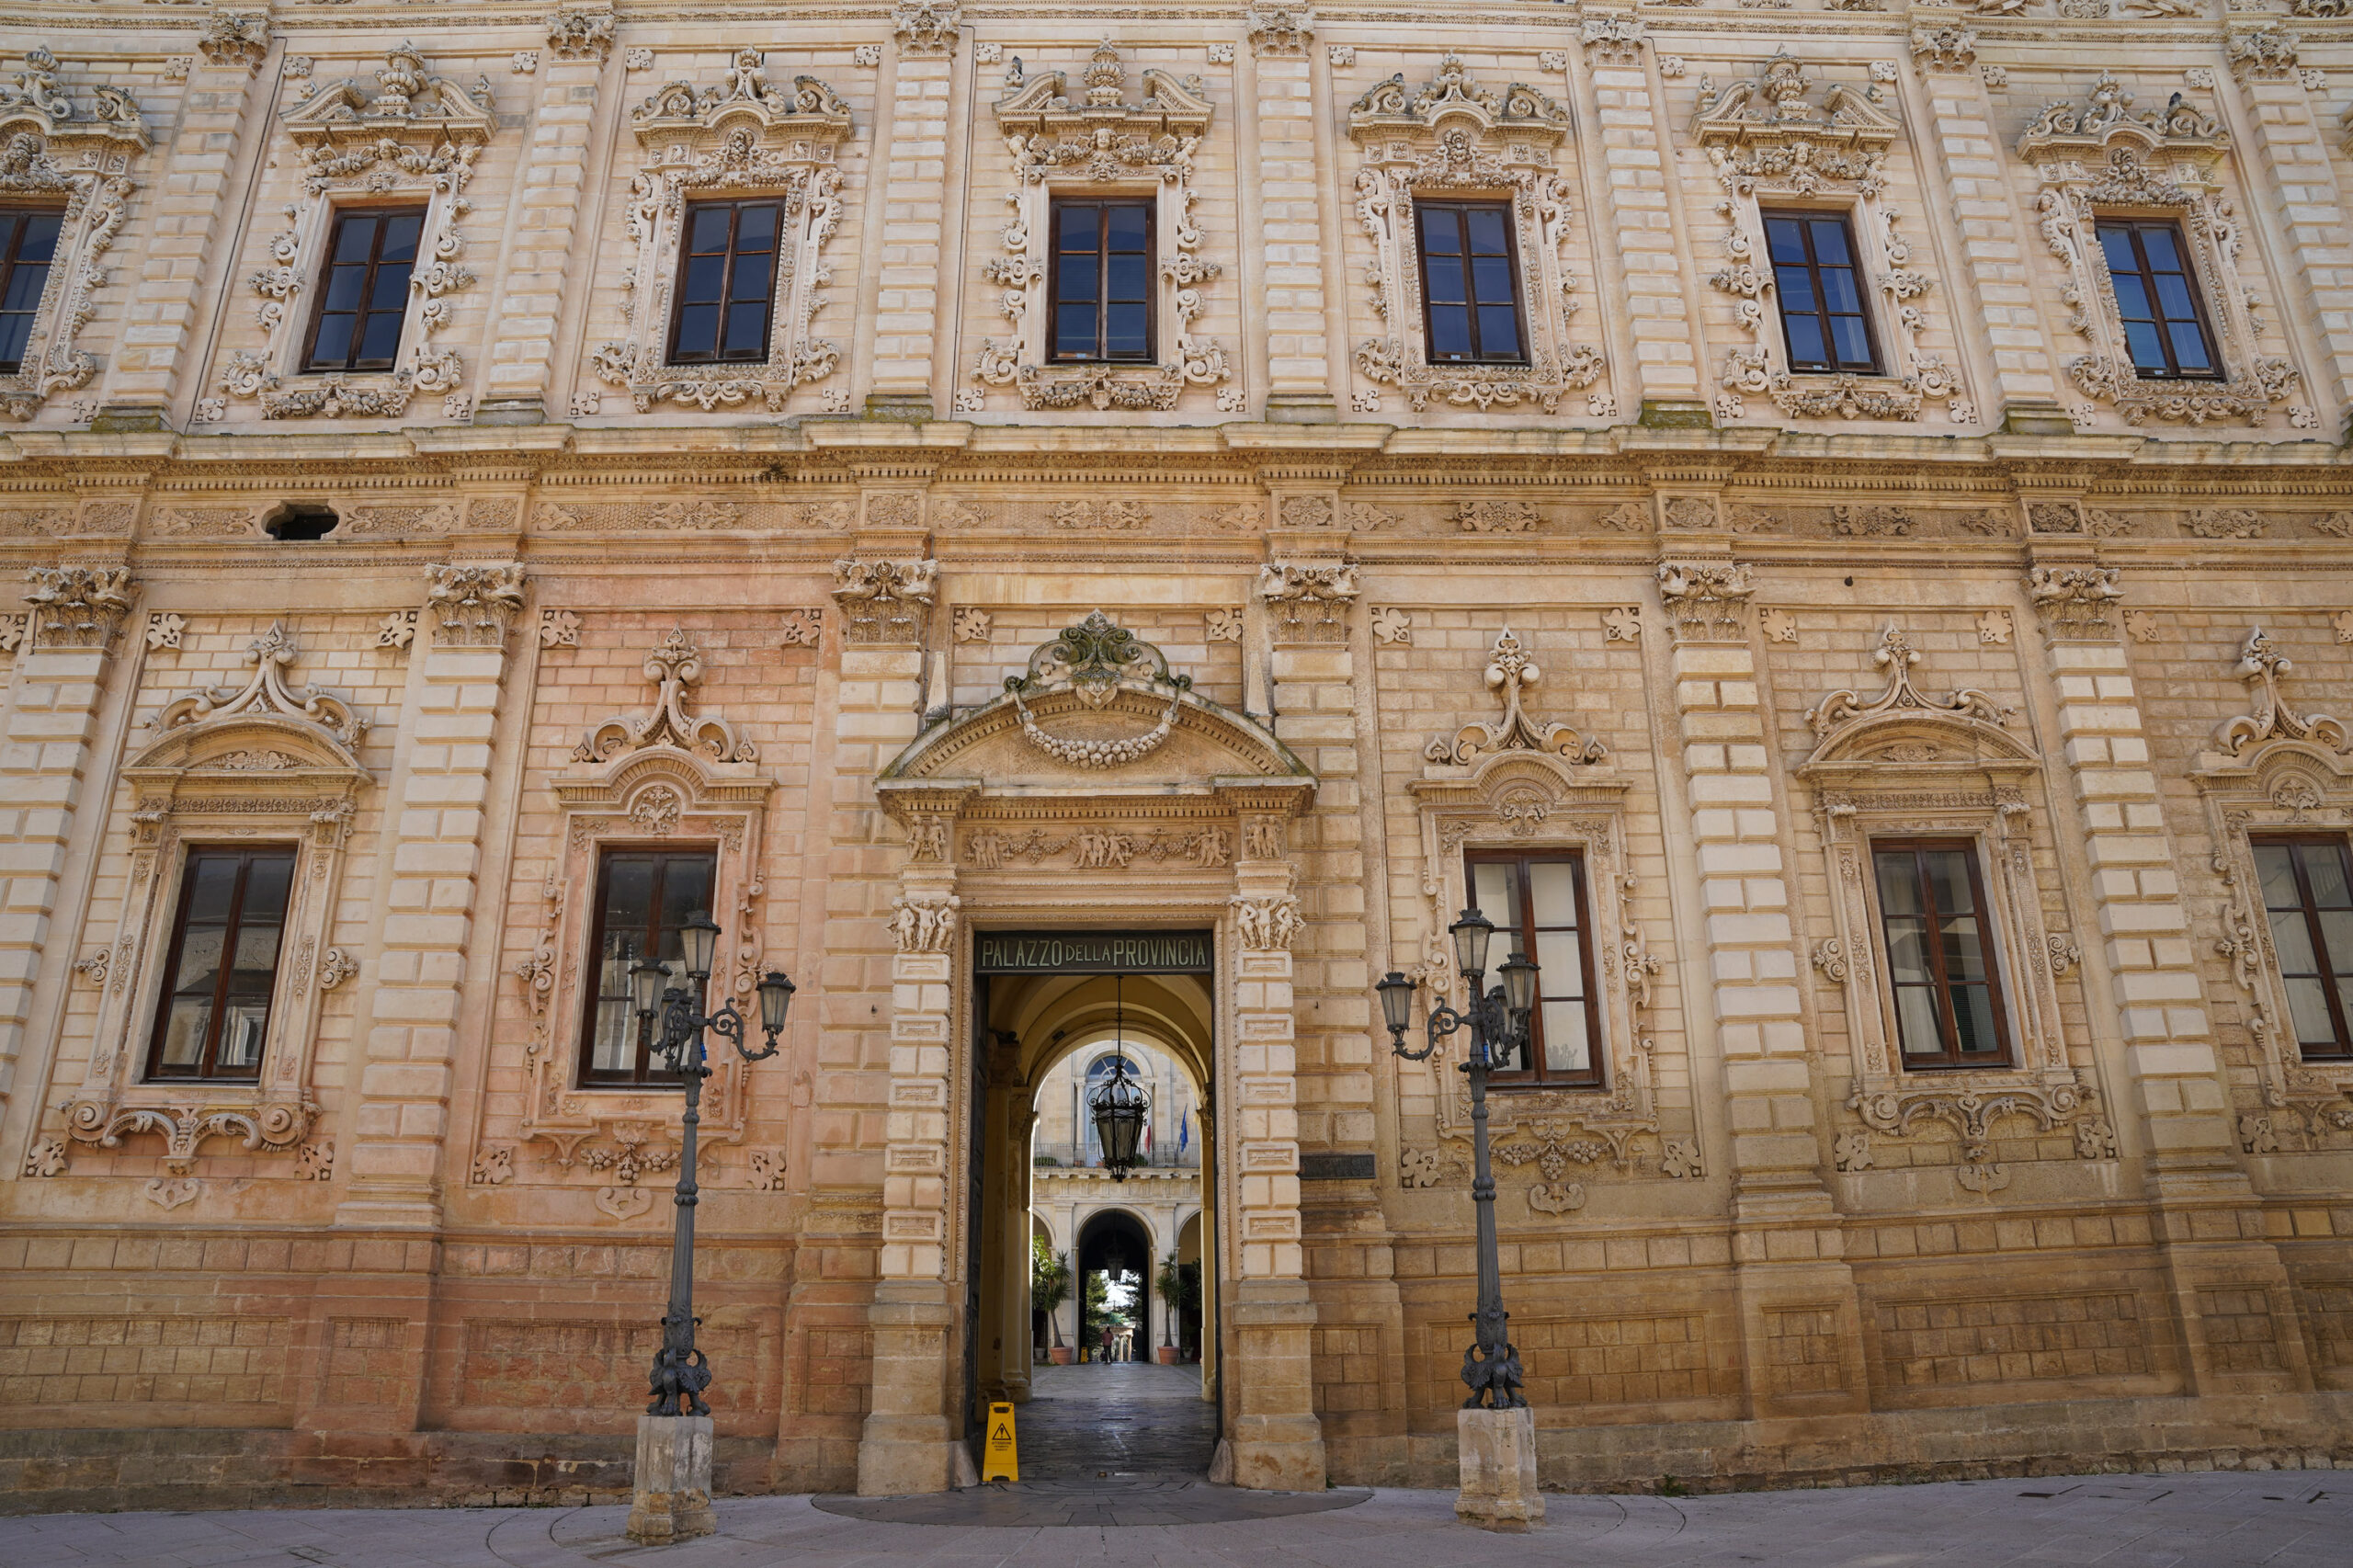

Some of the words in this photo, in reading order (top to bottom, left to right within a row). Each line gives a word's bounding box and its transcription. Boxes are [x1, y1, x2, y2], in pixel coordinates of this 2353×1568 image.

[983, 940, 1063, 966] PALAZZO
[1065, 944, 1111, 961] DELLA
[1113, 939, 1206, 966] PROVINCIA
